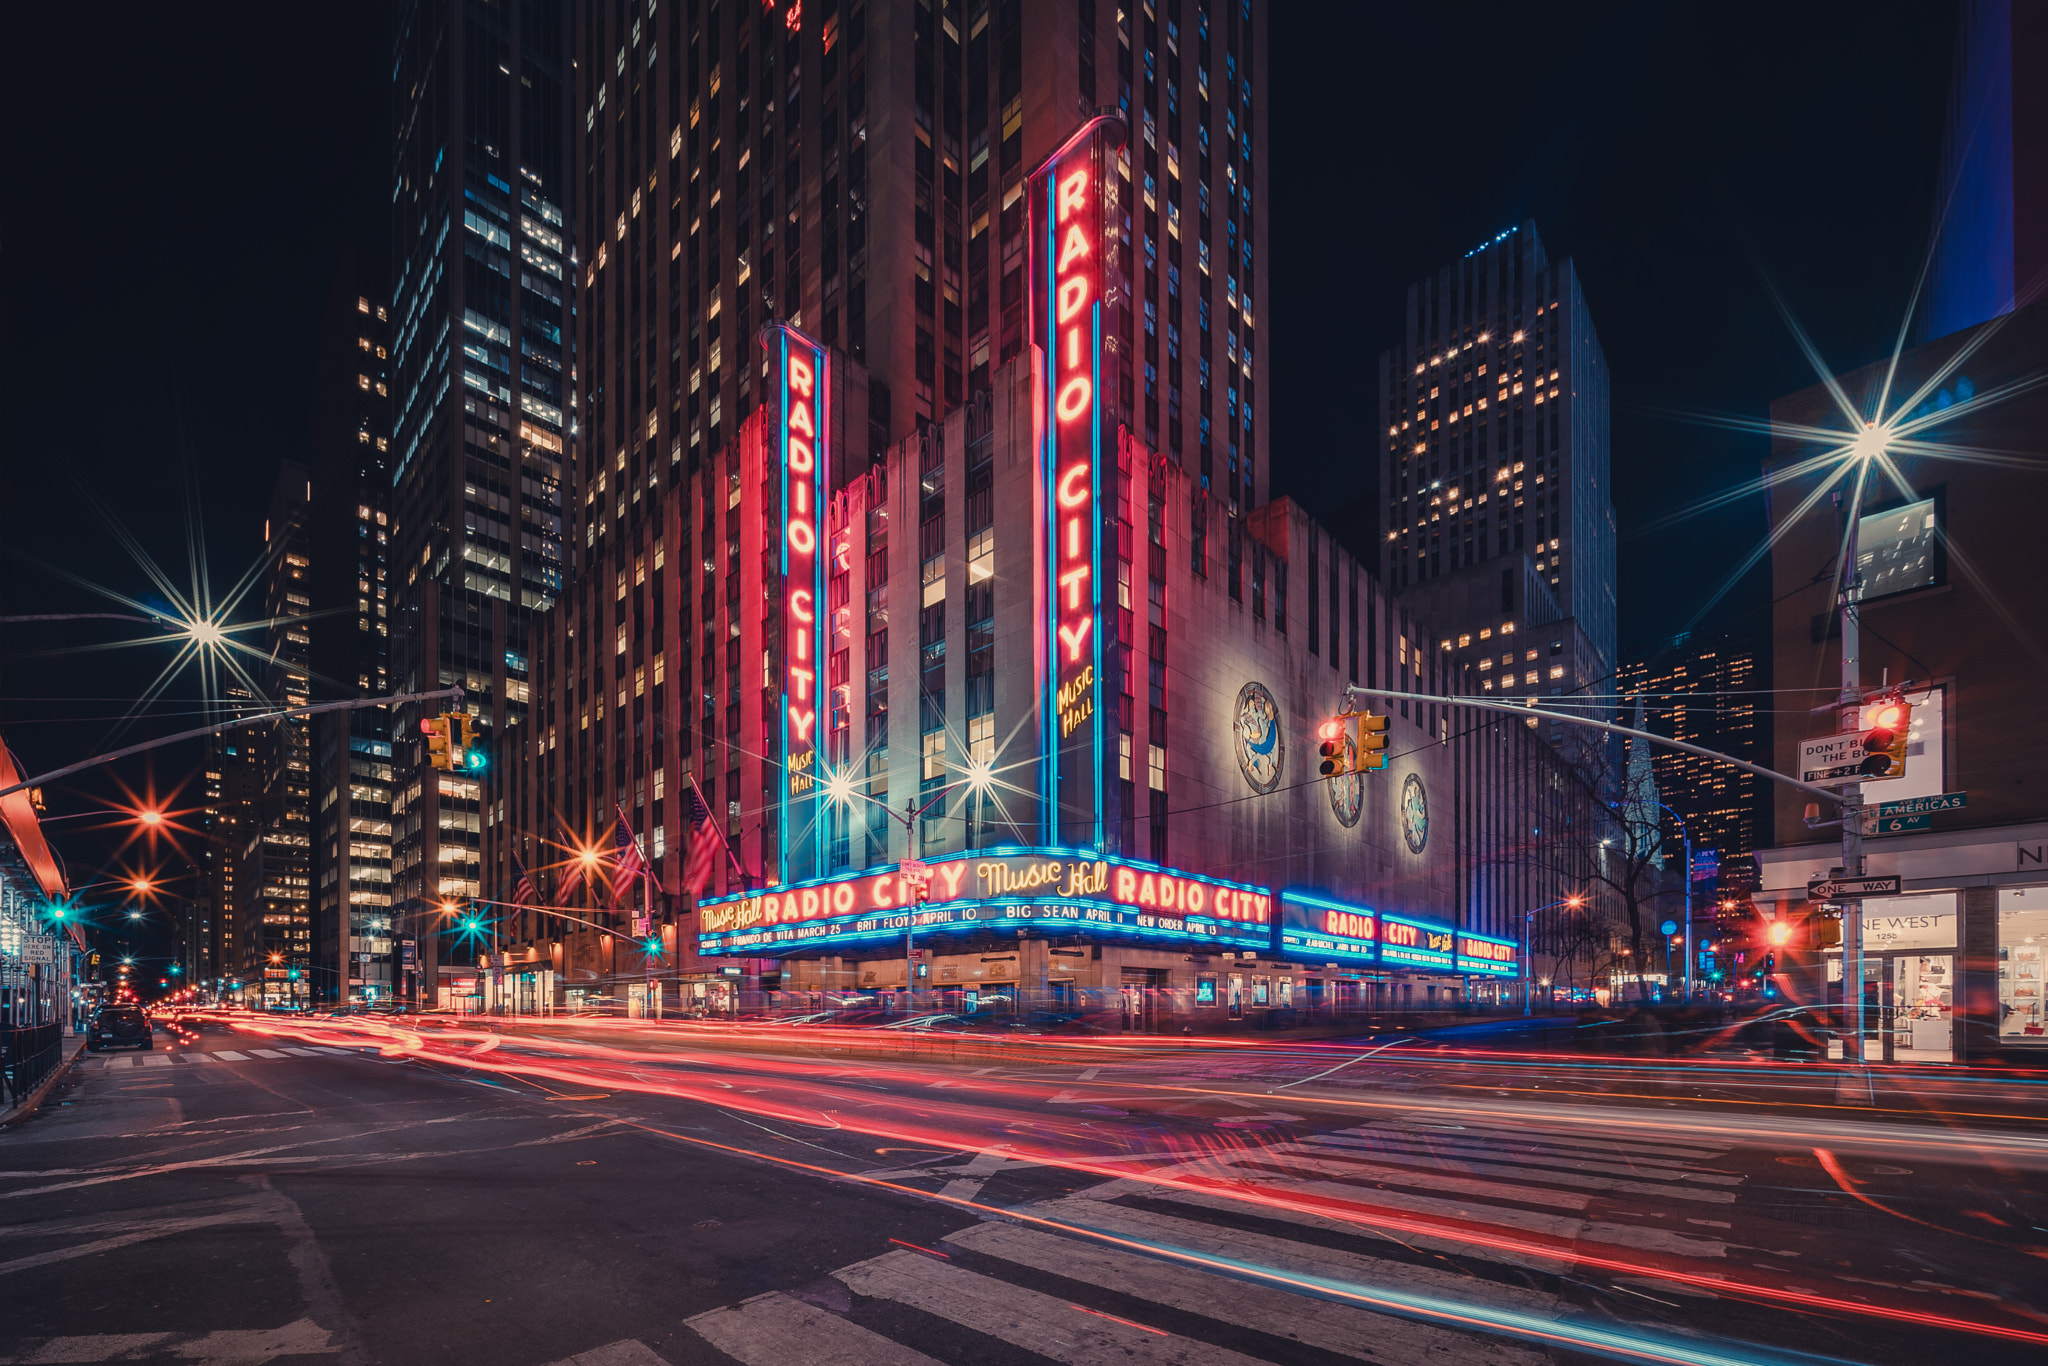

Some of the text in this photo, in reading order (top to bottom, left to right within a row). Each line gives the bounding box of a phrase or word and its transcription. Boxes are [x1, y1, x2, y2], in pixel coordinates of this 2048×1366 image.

[1058, 170, 1092, 661] RADIO CITY
[788, 357, 815, 740] RADIO CITY
[1057, 665, 1094, 716] MUSIC
[1063, 697, 1094, 739] HALL
[1806, 741, 1844, 755] DON'T
[1822, 749, 1870, 763] THE BO
[788, 750, 814, 775] MUSIC
[1807, 768, 1831, 781] FINE
[1834, 765, 1851, 775] +2
[791, 774, 814, 796] HALL
[1884, 798, 1961, 816] AMERICAS
[1889, 820, 1902, 831] 6
[1056, 861, 1109, 897] Hall
[1817, 881, 1893, 894] ONE WAY
[764, 883, 855, 923] RADIO
[1118, 868, 1268, 922] RADIO CITY
[731, 896, 762, 930] Hall
[857, 908, 977, 932] BRIT FLOYD APRIL 10
[1006, 905, 1123, 923] BIG SEAN APRIL 11
[1887, 914, 1943, 928] WEST
[733, 924, 841, 946] FRANCO DE VITA MARCH 25
[1136, 915, 1217, 935] NEW ORDER APRIL 13
[1327, 910, 1374, 940] RADIO
[1388, 923, 1417, 946] CITY
[23, 936, 51, 944] STOP
[1467, 938, 1493, 960] RADIO
[1494, 944, 1511, 962] CITY
